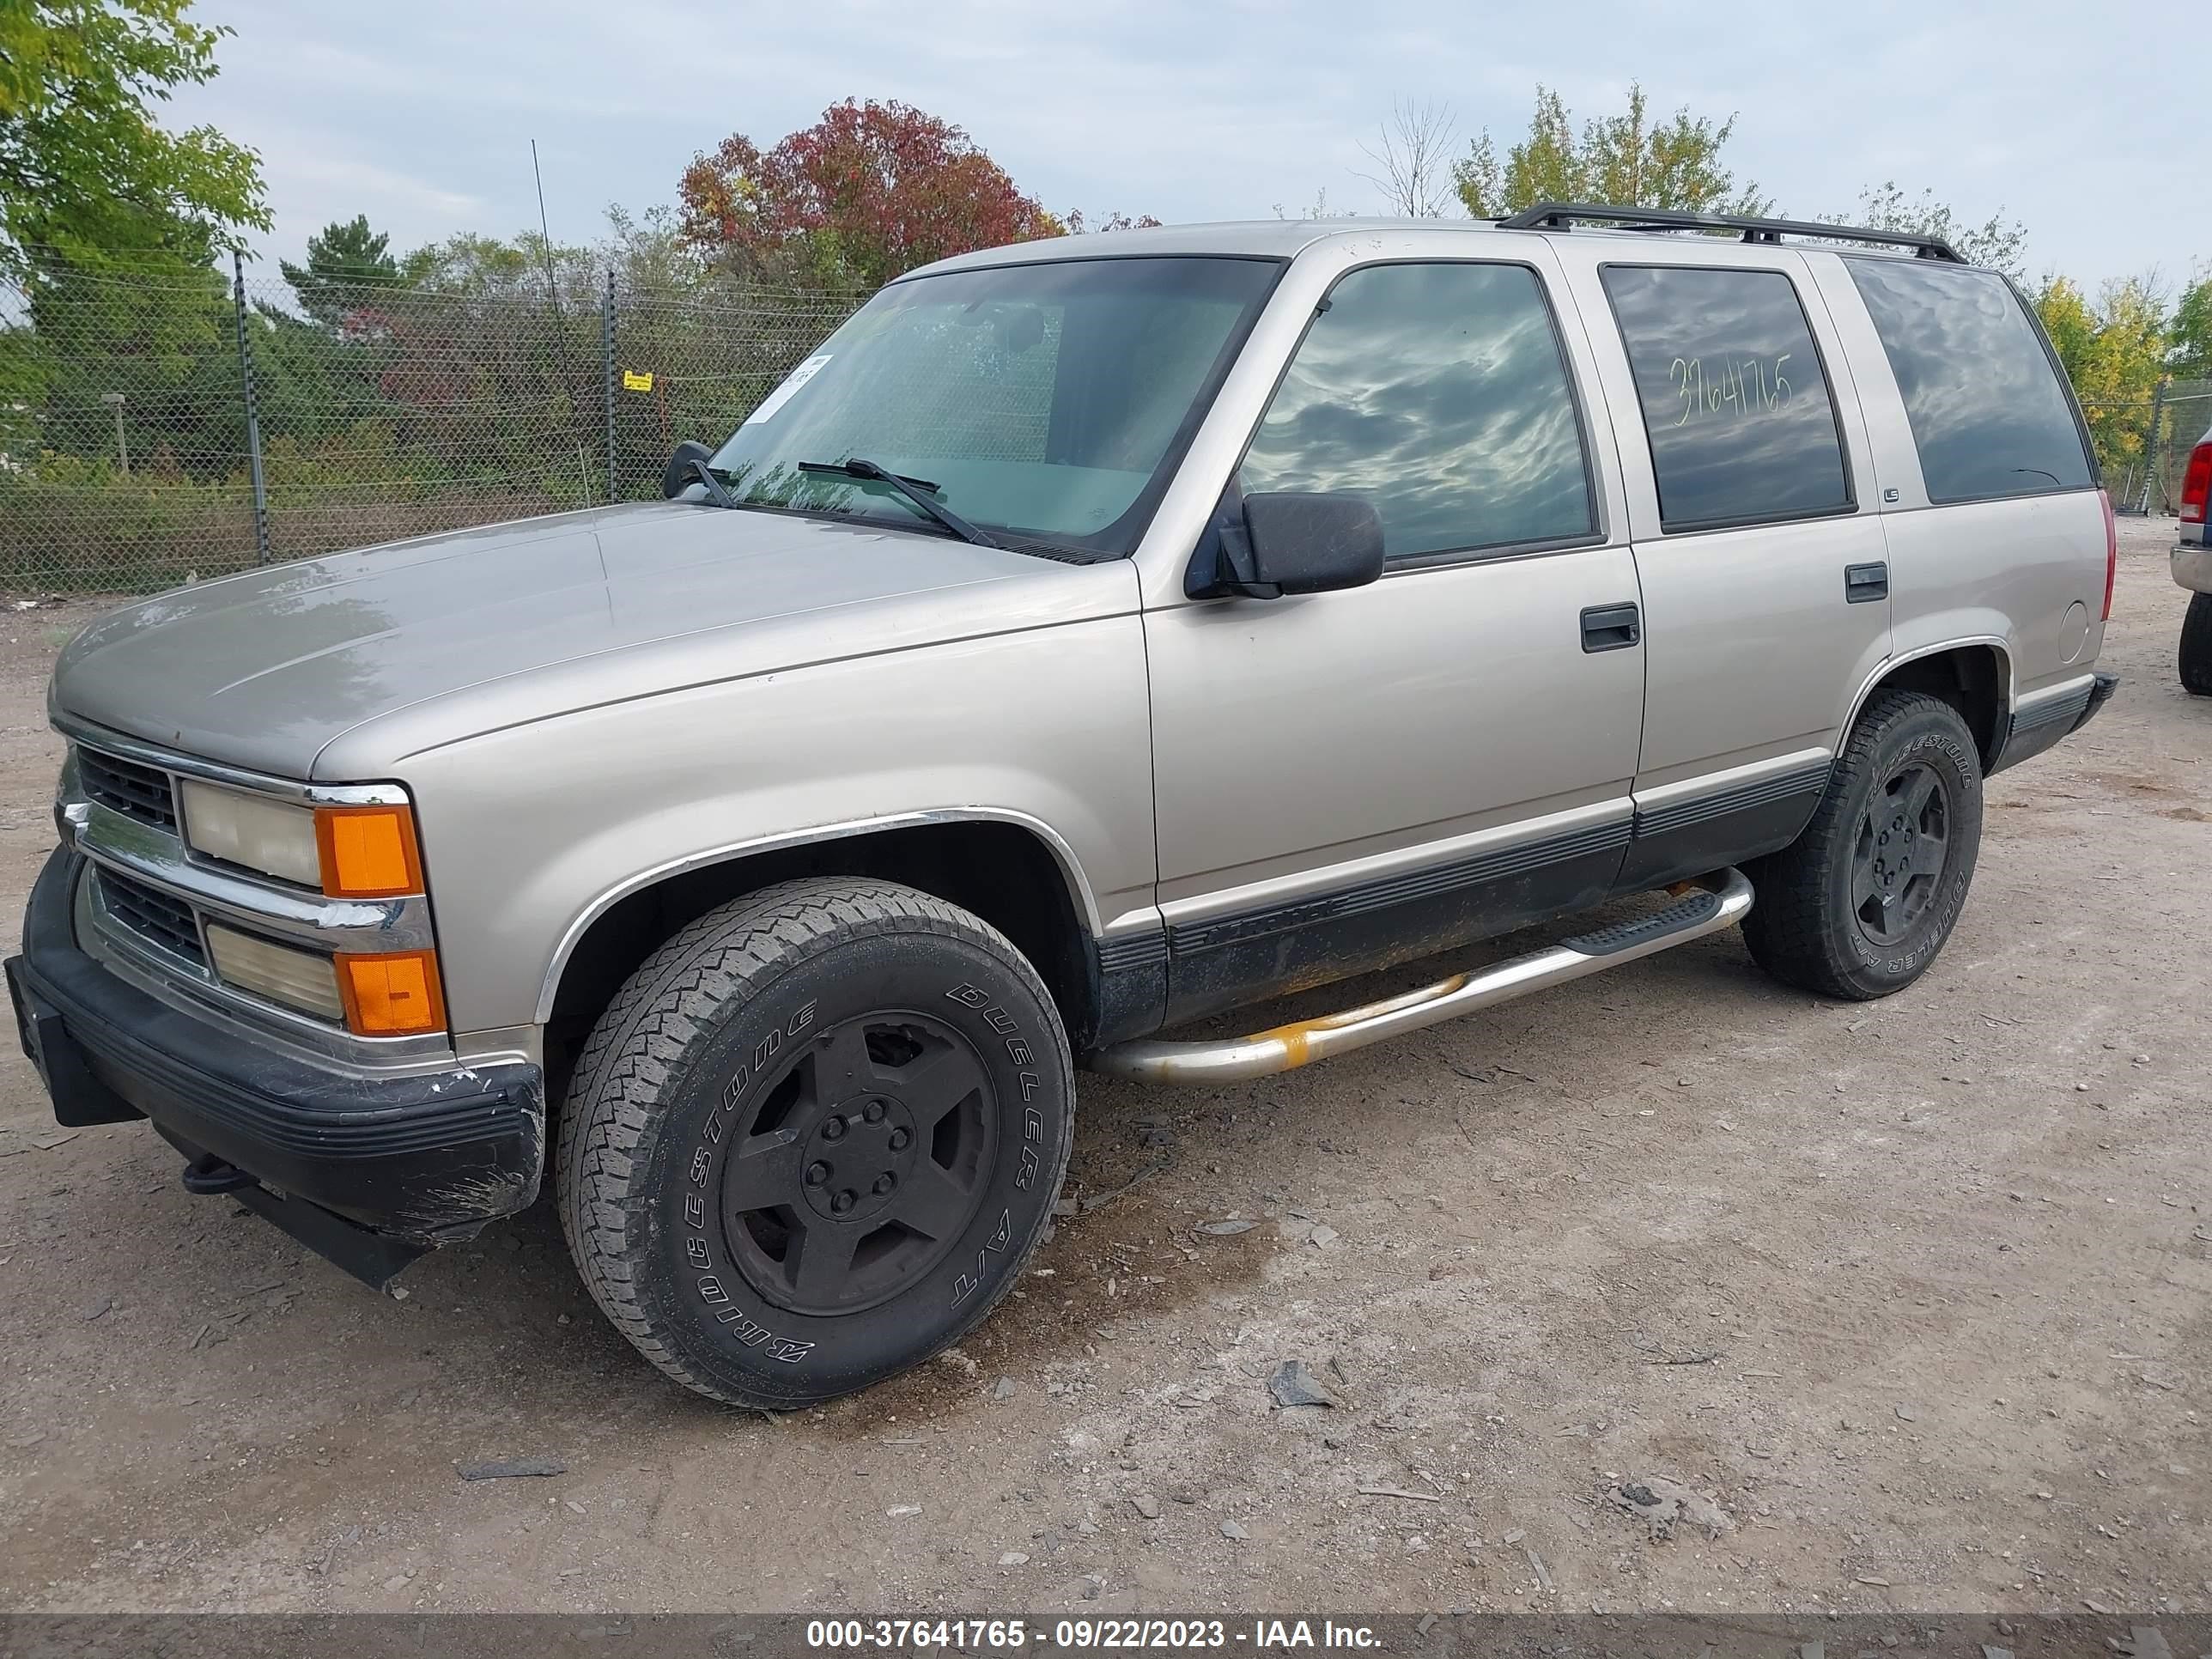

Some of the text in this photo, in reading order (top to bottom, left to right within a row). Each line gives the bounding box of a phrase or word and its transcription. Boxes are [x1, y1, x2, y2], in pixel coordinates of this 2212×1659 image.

[1670, 353, 1792, 426] 37641765
[1885, 489, 1899, 501] LS
[1887, 872, 1966, 973] DUELER
[684, 999, 817, 1363] BRIDGESTONE
[945, 982, 1044, 1310] DUELER A/T
